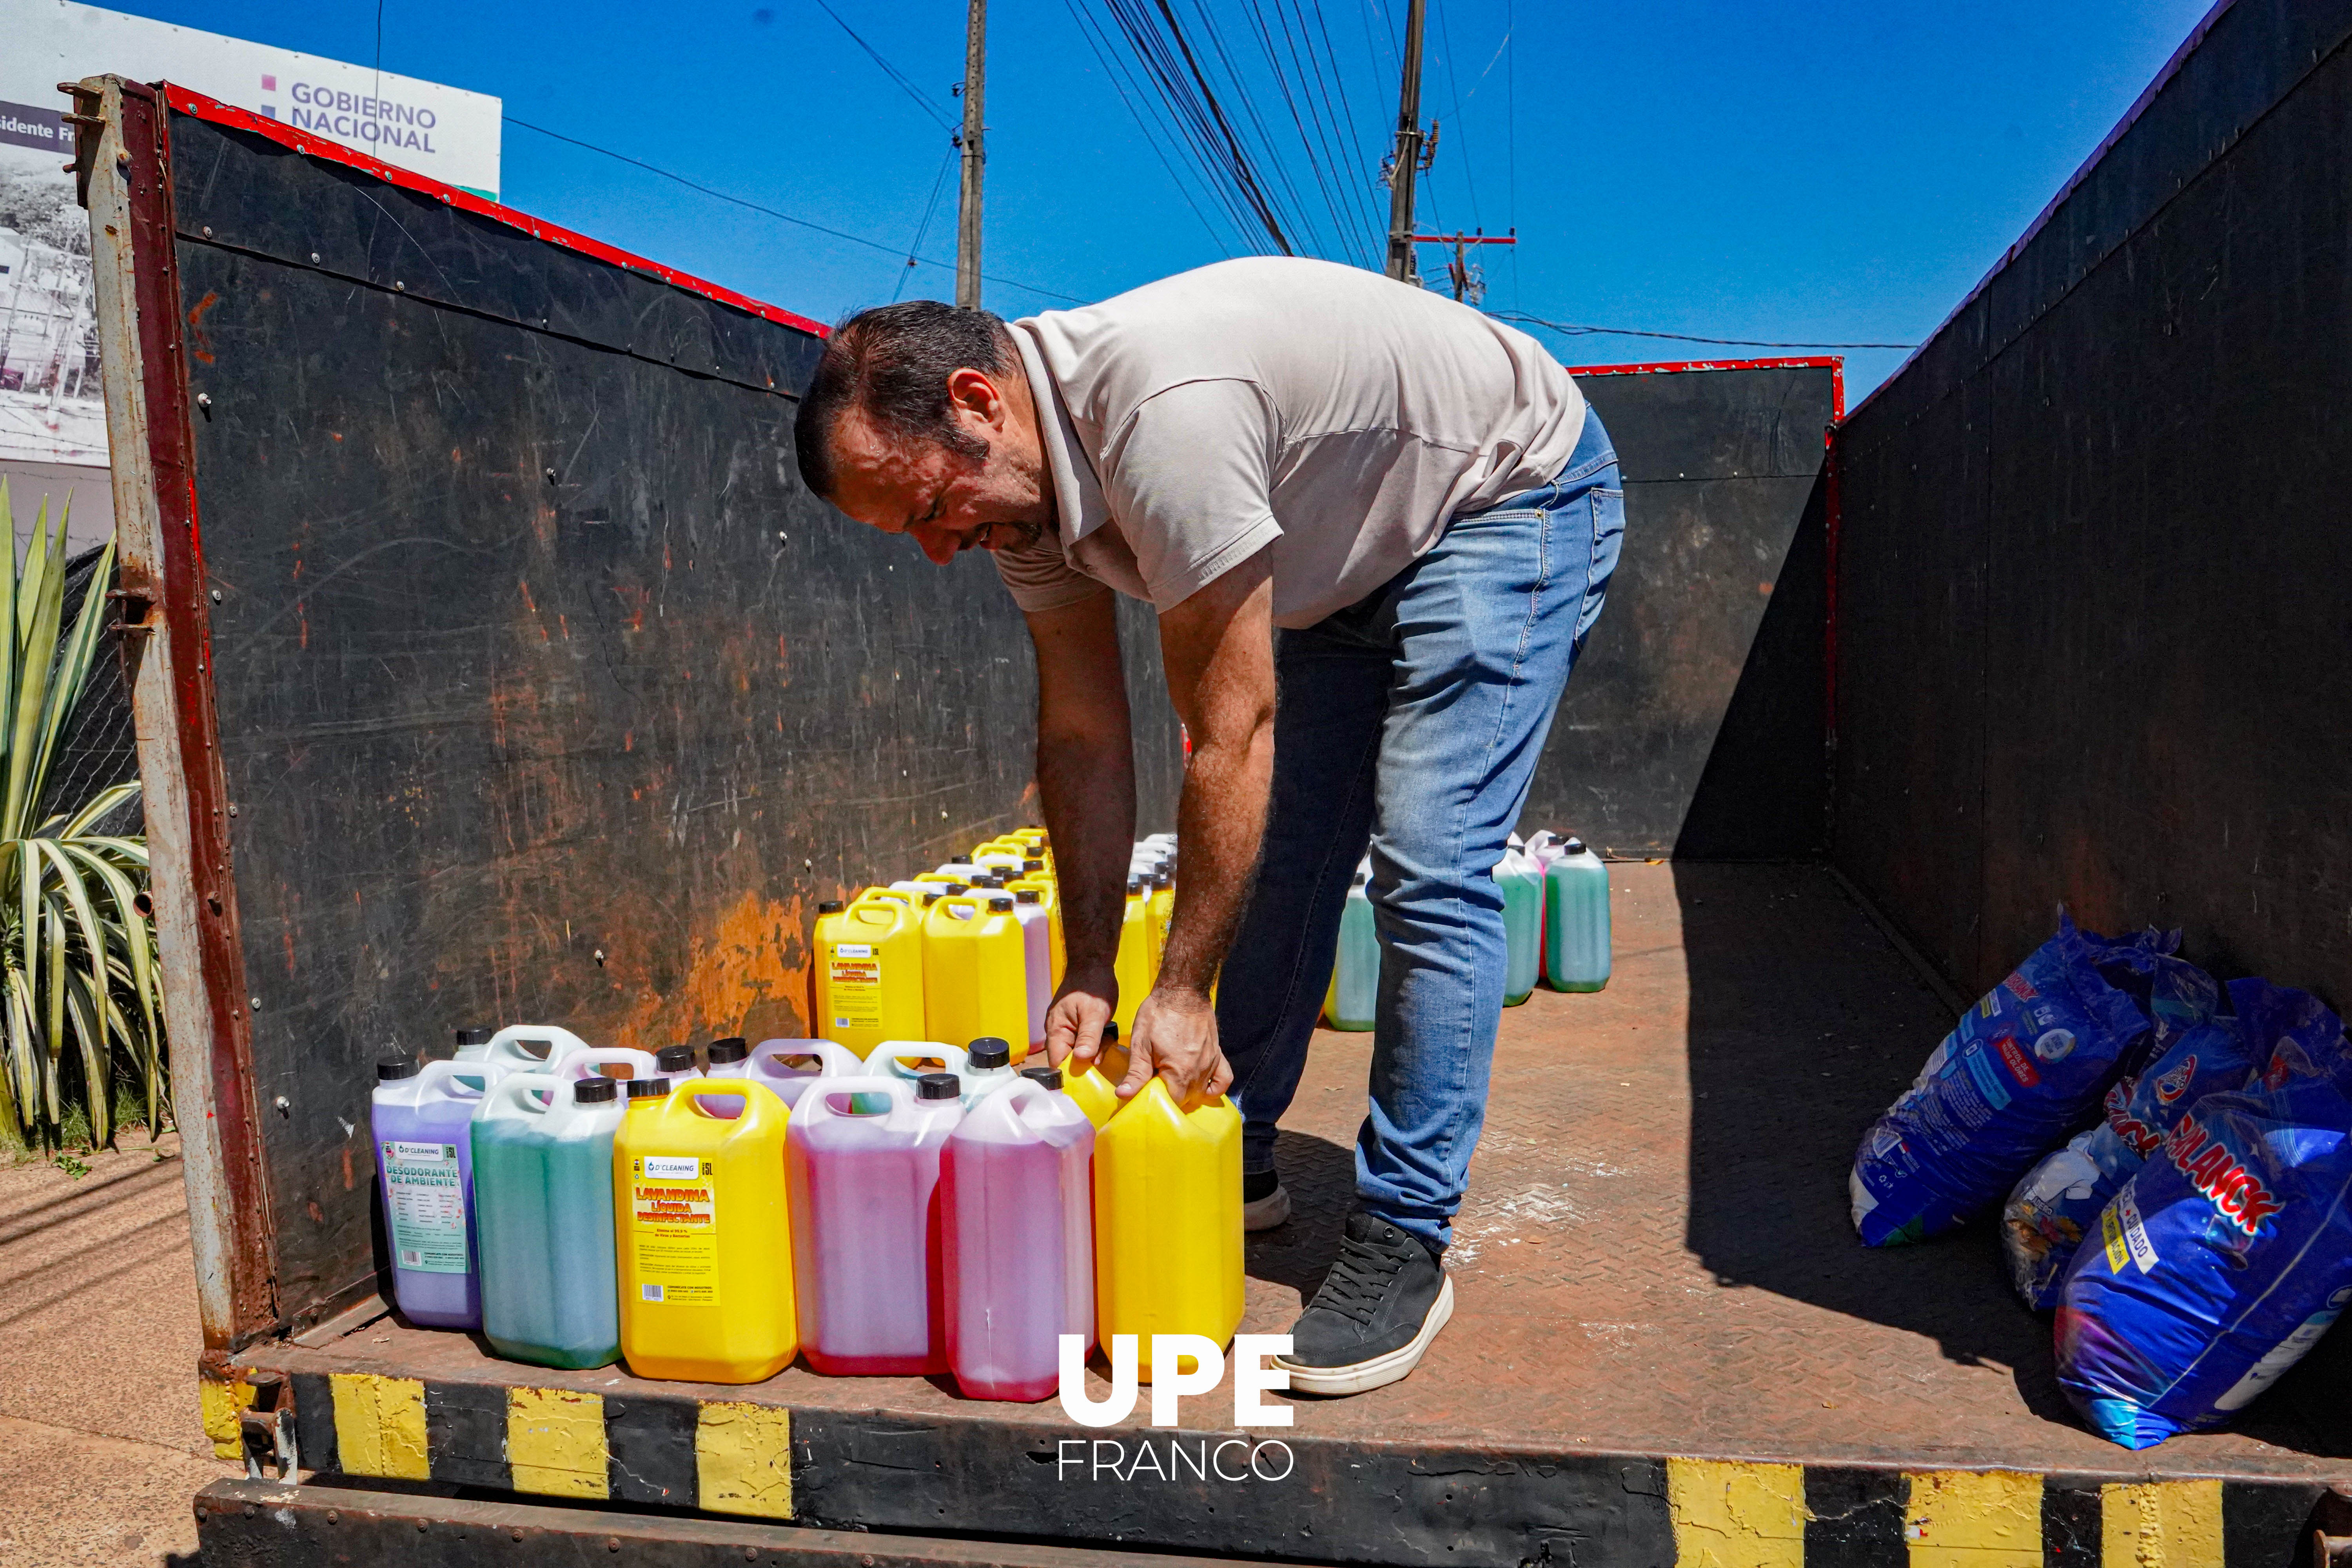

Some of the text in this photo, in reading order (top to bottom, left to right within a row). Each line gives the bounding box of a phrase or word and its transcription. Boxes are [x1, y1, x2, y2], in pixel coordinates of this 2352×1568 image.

[291, 83, 436, 129] GOBIERNO
[292, 106, 436, 153] NACIONAL
[832, 962, 878, 971] LAVANDINA
[386, 1165, 458, 1178] DESODORANTE
[391, 1175, 456, 1186] DE AMBIENTE
[636, 1187, 710, 1202] LAVANDINA
[651, 1200, 691, 1213] LÍQUIDA
[637, 1212, 710, 1223] DESINFECTANTE
[2126, 1213, 2148, 1258] CUIDADO
